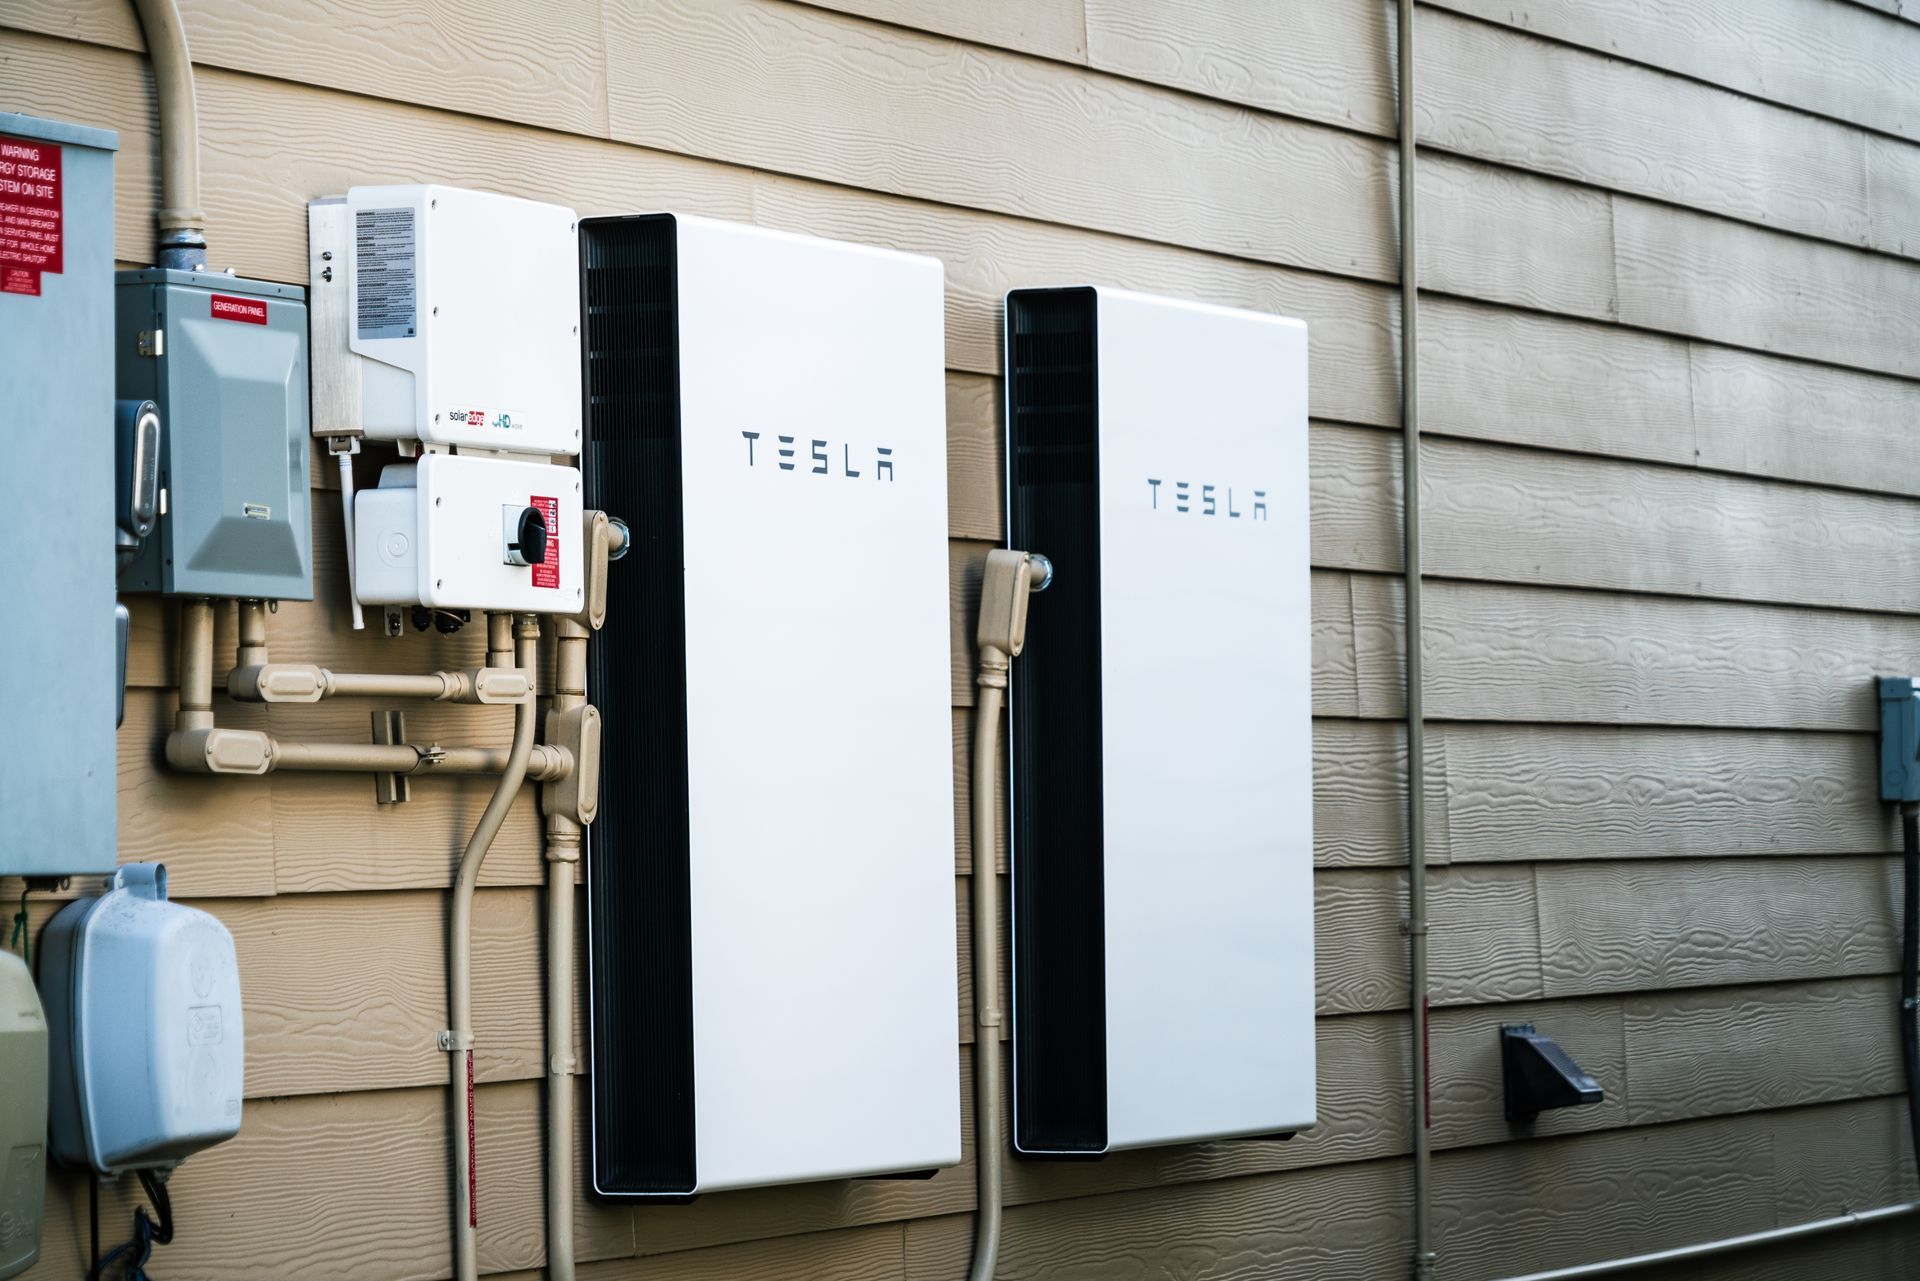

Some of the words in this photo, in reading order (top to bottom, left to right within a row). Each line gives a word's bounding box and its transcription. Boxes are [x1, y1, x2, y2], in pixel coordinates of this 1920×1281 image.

[1, 144, 39, 161] WARNING
[17, 164, 56, 182] STORAGE
[22, 182, 34, 195] ON
[36, 184, 54, 198] SITE
[26, 206, 59, 219] GENERATION
[31, 219, 55, 230] BREAKER
[4, 227, 26, 238] SERVICE
[26, 230, 43, 240] PANEL
[44, 233, 59, 242] MUST
[20, 242, 40, 252] WHOLE
[40, 244, 56, 254] HOME
[22, 253, 47, 264] SHUTOFF
[213, 300, 247, 314] GENERATION
[248, 306, 265, 317] PANEL
[742, 431, 892, 482] TESLA
[1148, 478, 1266, 520] TESLA
